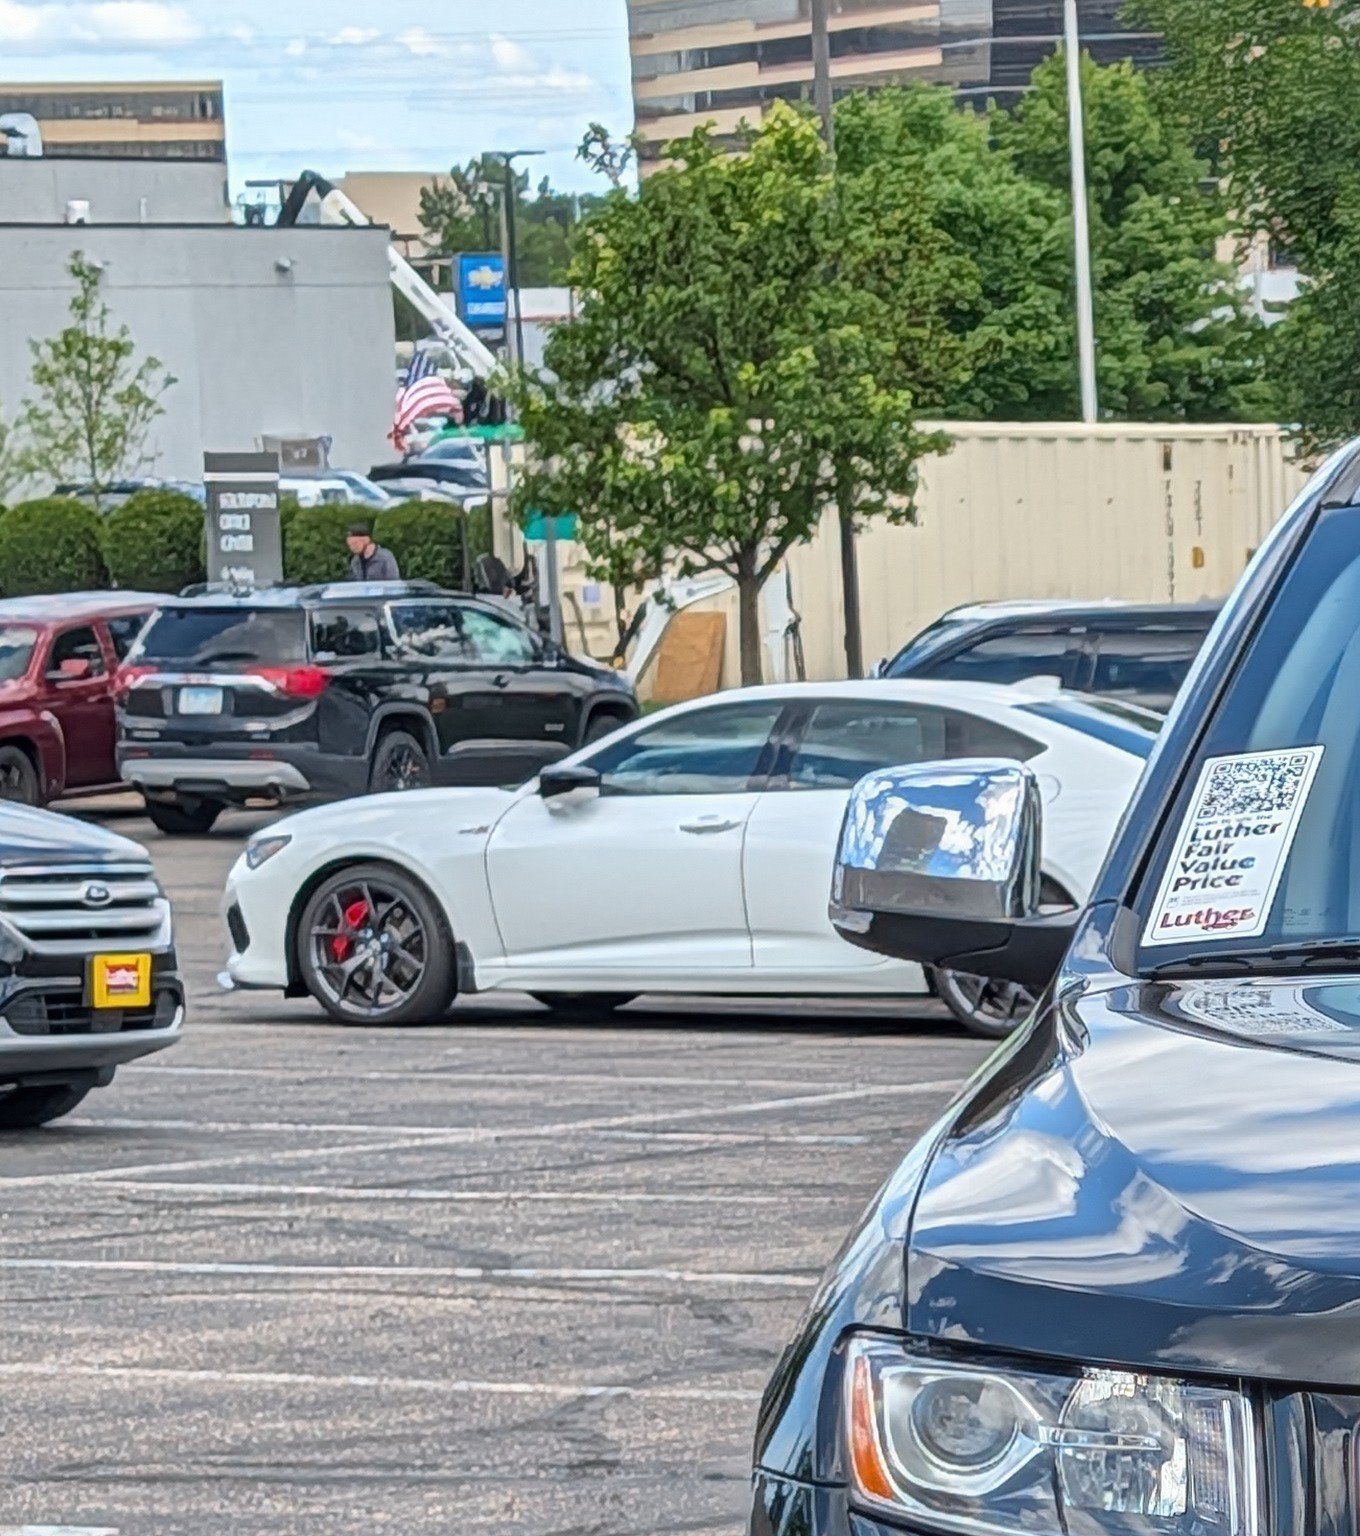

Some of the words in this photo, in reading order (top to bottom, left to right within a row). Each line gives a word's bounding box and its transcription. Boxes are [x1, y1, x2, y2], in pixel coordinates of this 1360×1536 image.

[1190, 822, 1283, 842] Luther
[1184, 841, 1235, 859] Fair
[1180, 857, 1256, 874] Value
[1172, 874, 1244, 892] Price
[1160, 908, 1254, 928] Luther
